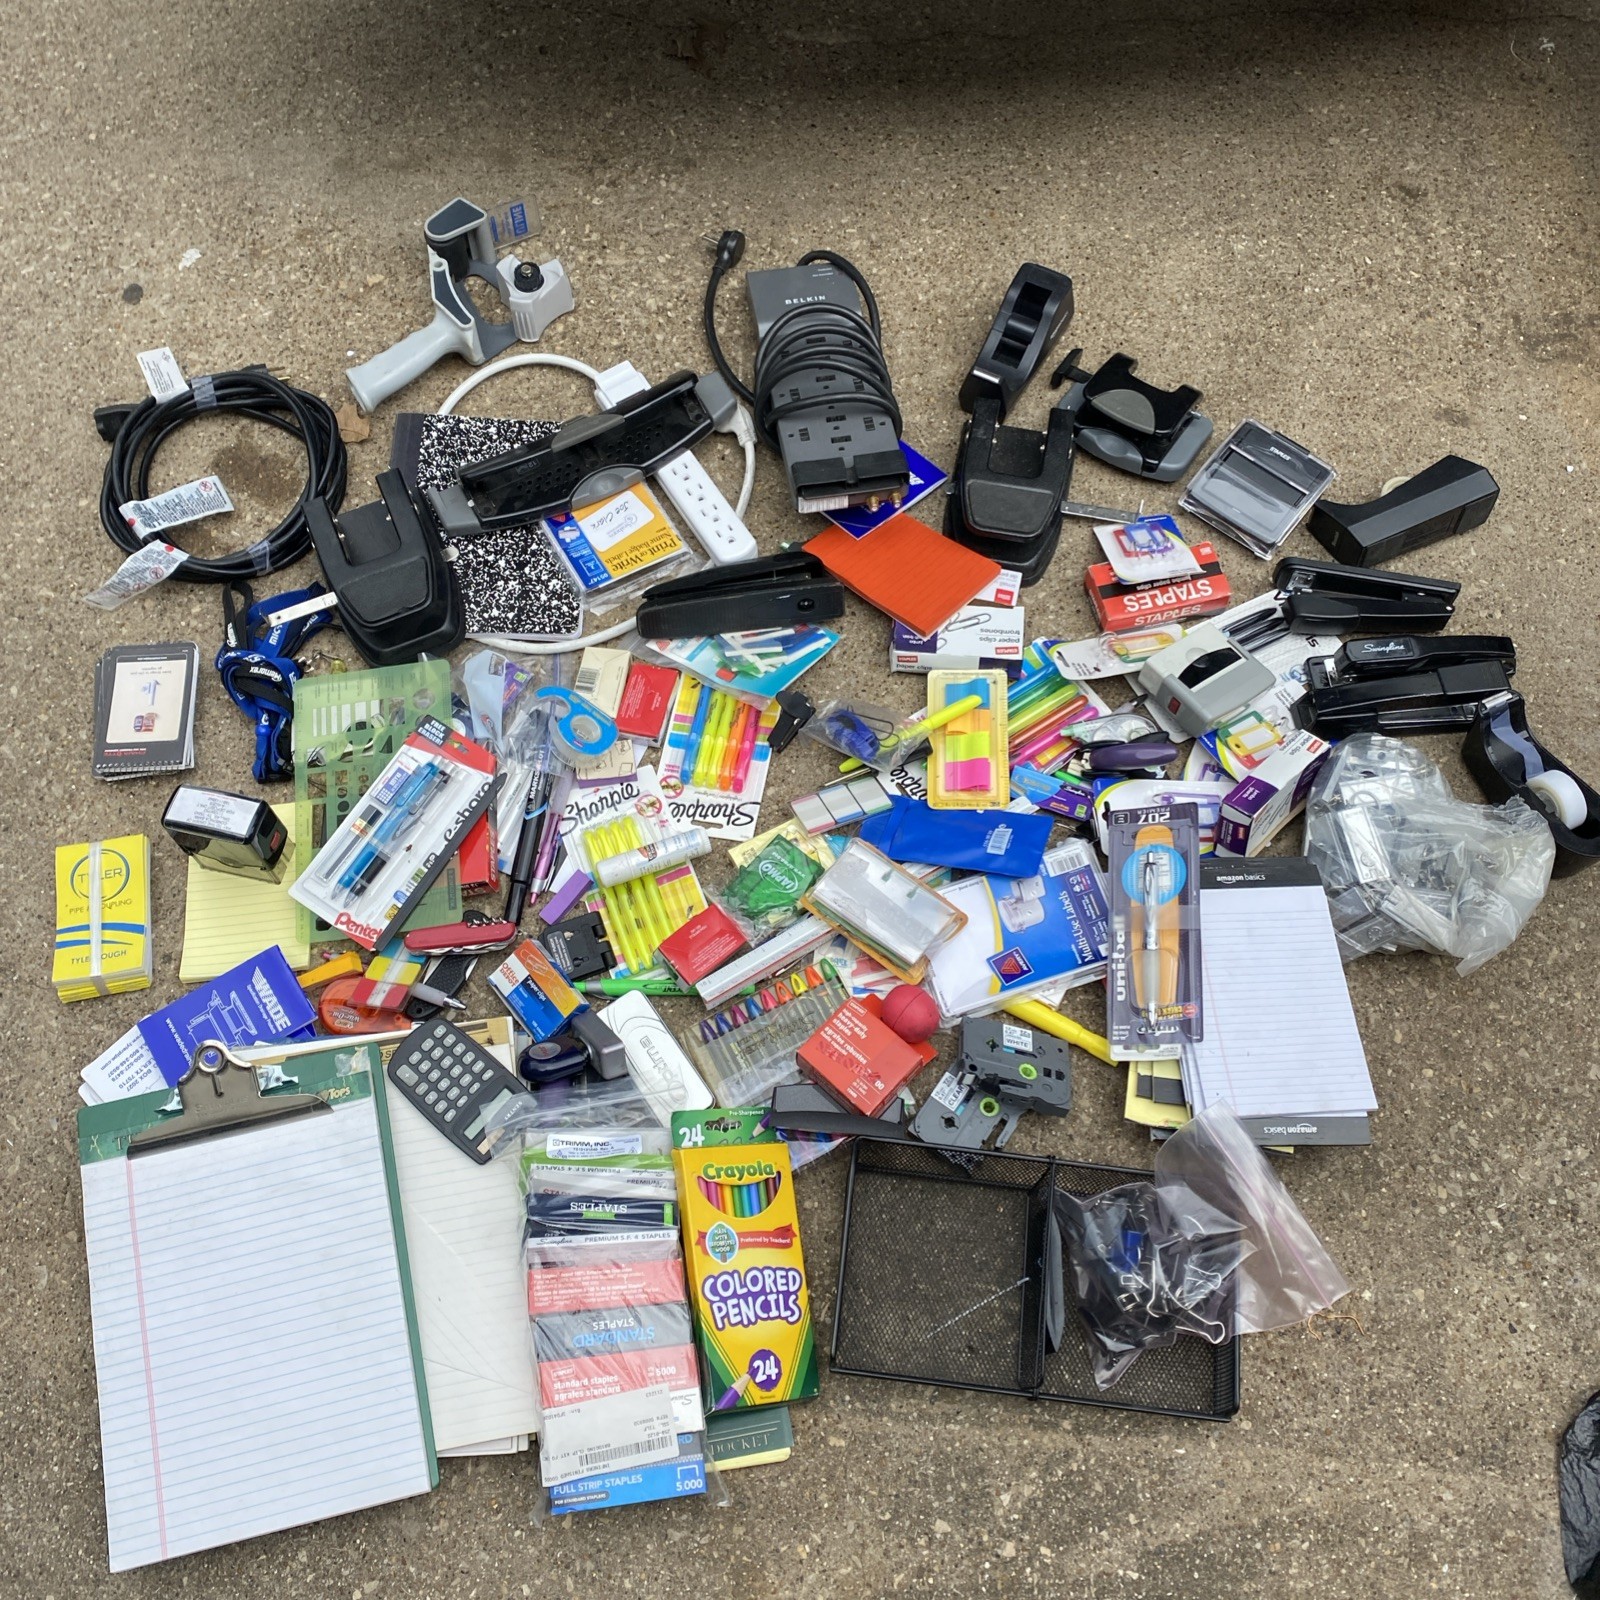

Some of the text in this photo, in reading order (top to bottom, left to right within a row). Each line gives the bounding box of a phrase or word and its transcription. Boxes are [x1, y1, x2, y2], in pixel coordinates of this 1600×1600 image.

[785, 294, 826, 305] BELKIN
[604, 530, 671, 565] Name Badge Labels
[610, 536, 677, 574] Print or Write
[1124, 580, 1212, 612] STAPLES
[1134, 605, 1200, 626] STAPLES
[998, 636, 1019, 644] paper
[1361, 642, 1406, 653] Swingline
[249, 664, 283, 682] Memorex
[423, 722, 444, 739] BLOCK
[430, 719, 446, 733] FREE
[560, 783, 640, 836] Sharpie
[668, 800, 761, 827] Sharpie
[1137, 806, 1171, 814] PREMIER
[1137, 812, 1170, 824] 207
[76, 867, 124, 884] TER
[1216, 873, 1266, 883] amazon basics
[69, 898, 134, 915] PIPE OUPLING
[1059, 890, 1076, 921] Labels
[334, 912, 383, 942] Pentel
[1068, 922, 1094, 962] Multi-Use
[1014, 951, 1029, 971] AVERY
[1112, 915, 1126, 1001] uni-ball
[499, 967, 516, 987] DEPOT
[501, 962, 520, 983] Office
[254, 977, 291, 1033] WADE
[831, 1017, 852, 1037] staples
[836, 1011, 867, 1040] heavy-duty
[823, 1025, 867, 1065] agrafes robustes
[1006, 1038, 1029, 1048] WHITE
[138, 1067, 151, 1080] BOX
[948, 1084, 966, 1107] CLEAR
[679, 1124, 705, 1147] 24
[1263, 1124, 1318, 1135] amazon basics
[703, 1161, 774, 1181] Crayola
[570, 1202, 628, 1211] STAPLES
[769, 1235, 791, 1243] Teachers!
[704, 1269, 800, 1301] COLORED
[712, 1294, 800, 1329] PENCILS
[593, 1318, 635, 1330] STAPLES
[573, 1327, 655, 1347] STANDARD
[753, 1355, 779, 1384] 24
[554, 1374, 618, 1390] standard staples
[554, 1385, 620, 1401] agrafes standard
[559, 1468, 584, 1478] FINISHED
[554, 1474, 643, 1495] FULL STRIP STAPLES
[564, 1496, 586, 1504] STANDARD
